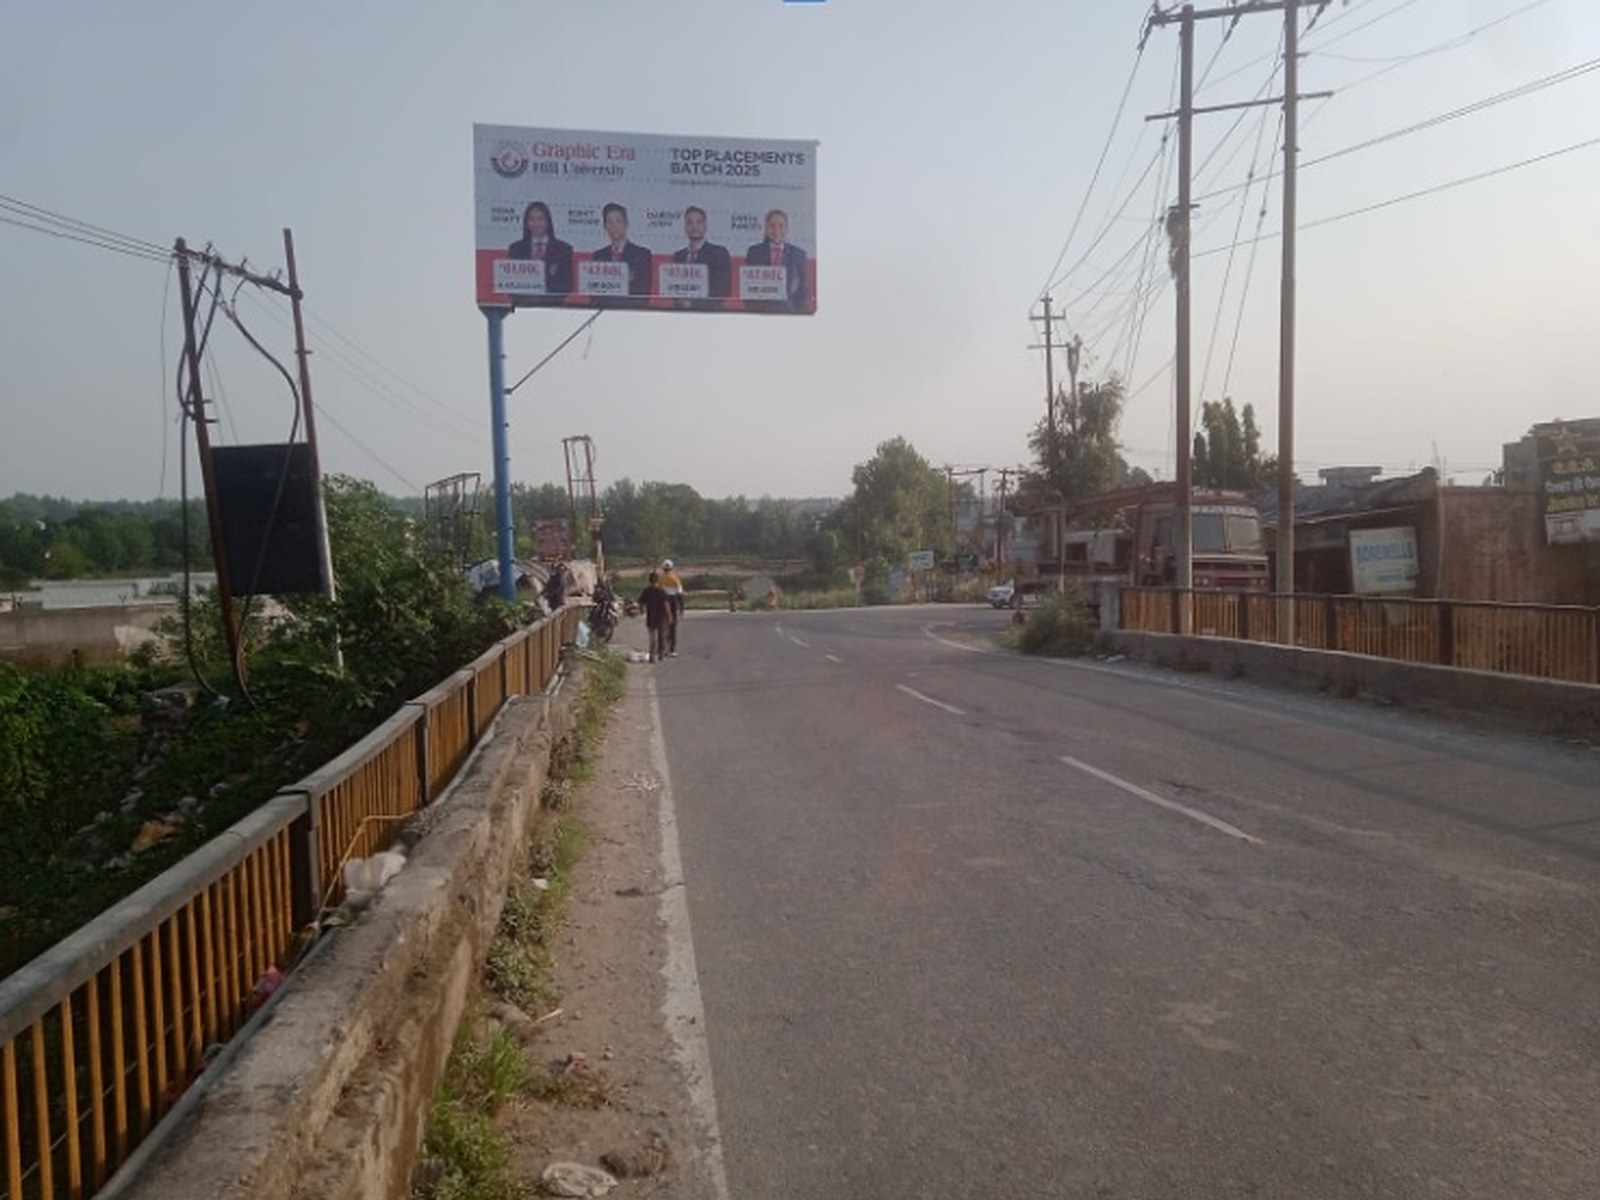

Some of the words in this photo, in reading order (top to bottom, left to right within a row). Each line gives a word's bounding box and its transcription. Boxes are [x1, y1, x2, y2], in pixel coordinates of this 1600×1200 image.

[533, 141, 599, 160] Graphic
[607, 144, 636, 161] Era
[671, 149, 701, 161] TOP
[705, 150, 806, 165] PLACEMENTS
[533, 161, 558, 174] Hill
[563, 162, 626, 177] University
[670, 162, 723, 175] BATCH
[725, 164, 761, 176] 2025
